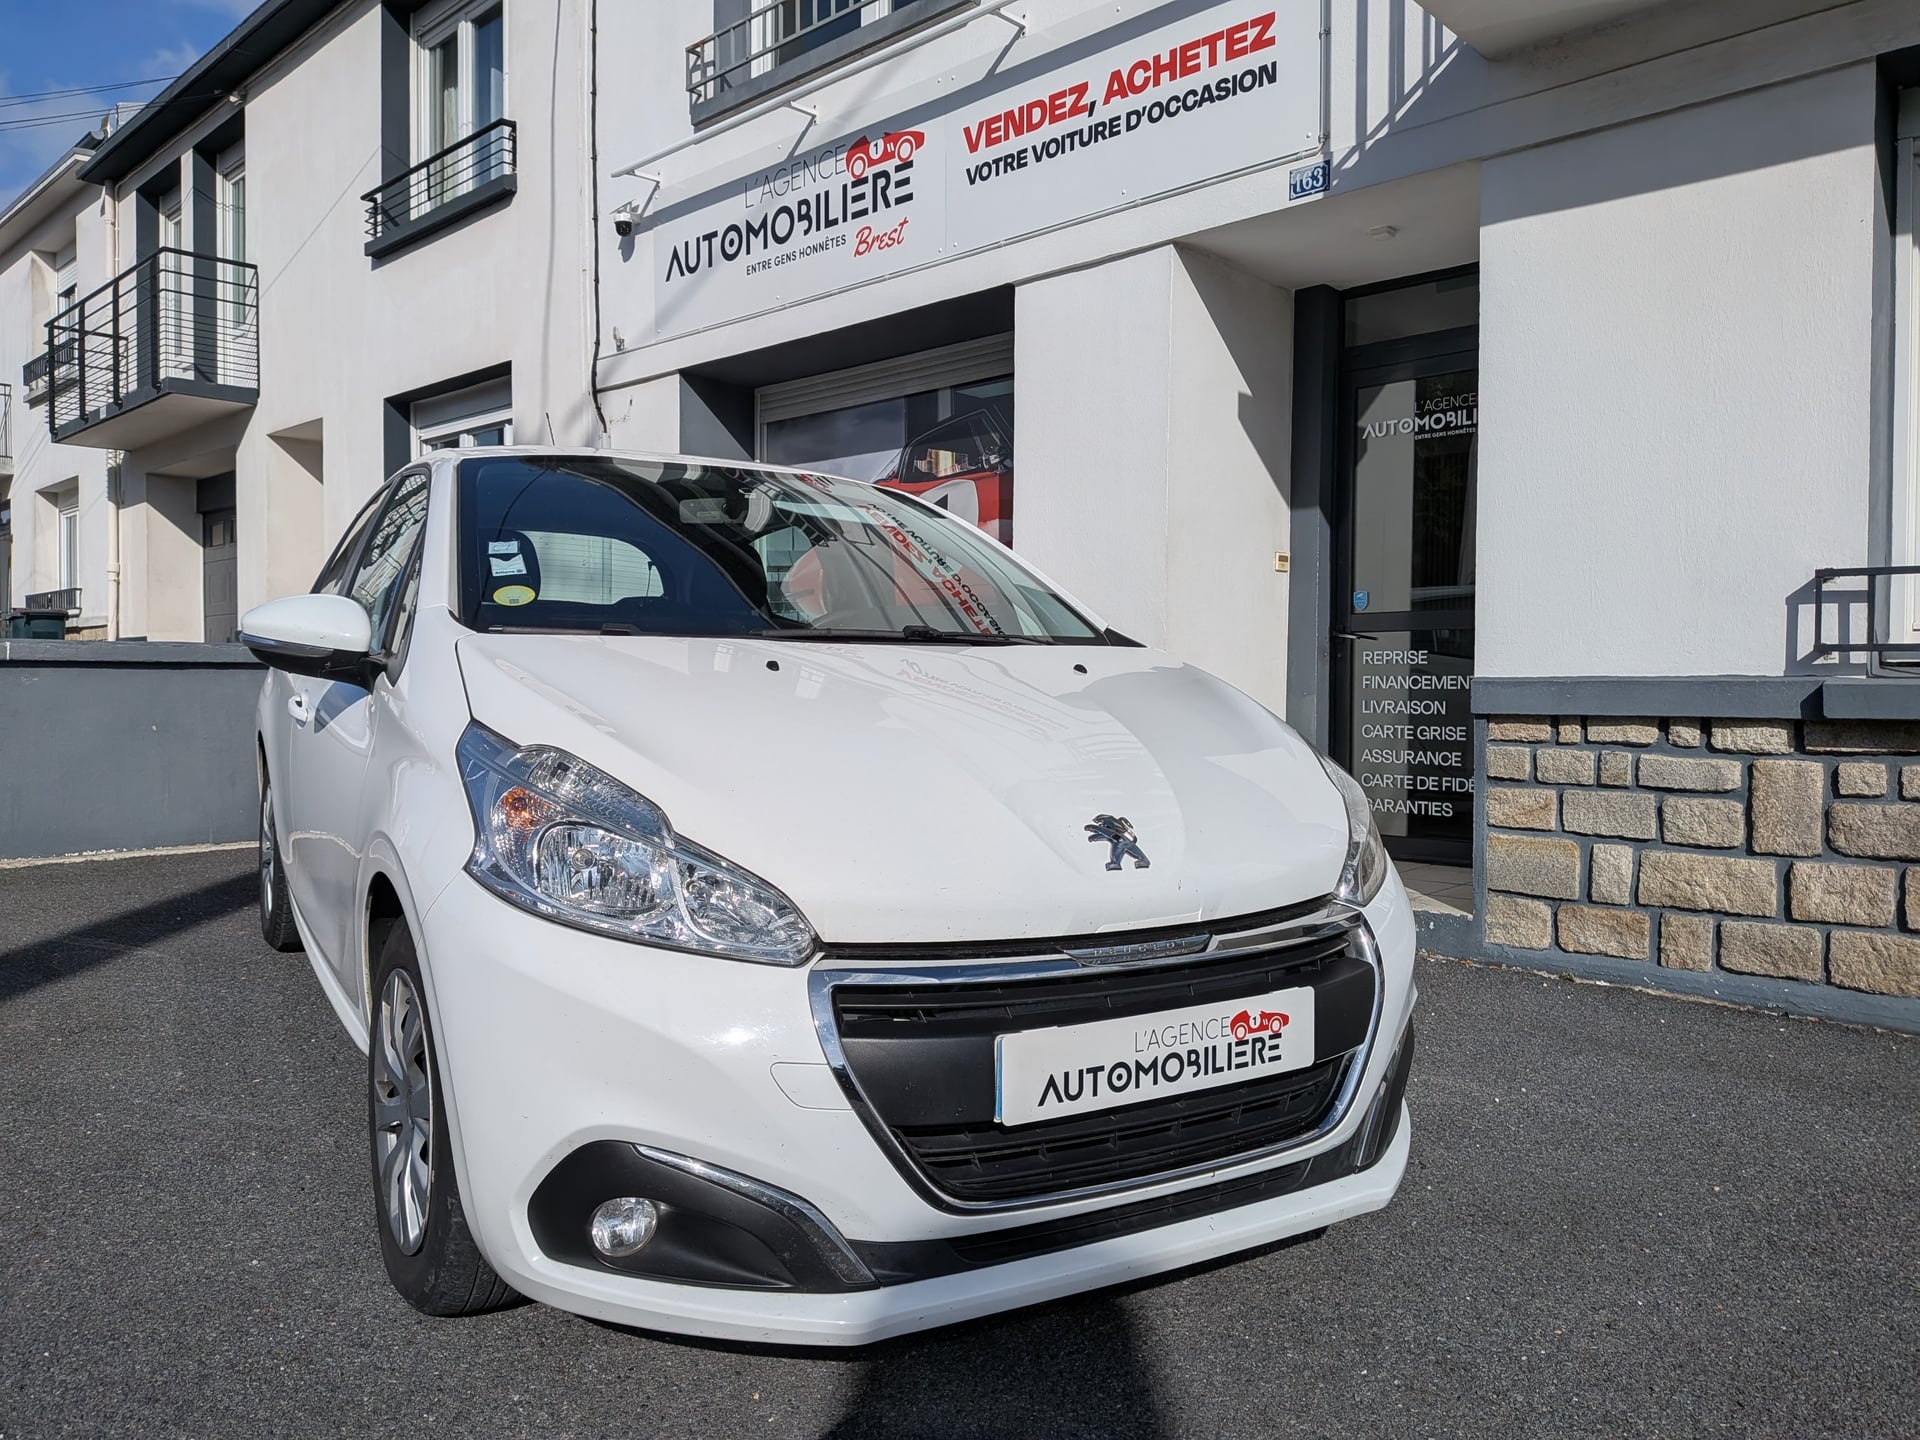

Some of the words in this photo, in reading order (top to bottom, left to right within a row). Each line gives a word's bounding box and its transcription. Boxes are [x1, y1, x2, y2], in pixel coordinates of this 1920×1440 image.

[962, 81, 1097, 154] VENDEZ,
[1102, 11, 1276, 106] ACHETEZ
[966, 148, 1029, 185] VOTRE
[1031, 115, 1121, 163] VOITURE
[1125, 61, 1277, 132] D'OCCASION
[744, 144, 847, 209] L'AGENCE
[1293, 168, 1324, 192] 163
[853, 217, 909, 258] Brest
[746, 260, 773, 276] ENTRE
[774, 251, 798, 268] GENS
[799, 234, 847, 259] HONNÊTES
[1414, 393, 1477, 413] L'AGENCE
[1414, 433, 1432, 441] ENTRE
[1432, 430, 1447, 438] GENS
[1362, 650, 1429, 665] REPRISE
[1362, 675, 1475, 690] FINANCEMEN
[1362, 700, 1447, 715] LIVRAISON
[1361, 724, 1414, 740] CARTE
[1417, 726, 1467, 741] GRISE
[1361, 749, 1462, 767] ASSURANCE
[1361, 773, 1414, 789] CARTE
[1417, 776, 1439, 791] DE
[1133, 1015, 1230, 1053] L'AGENCE
